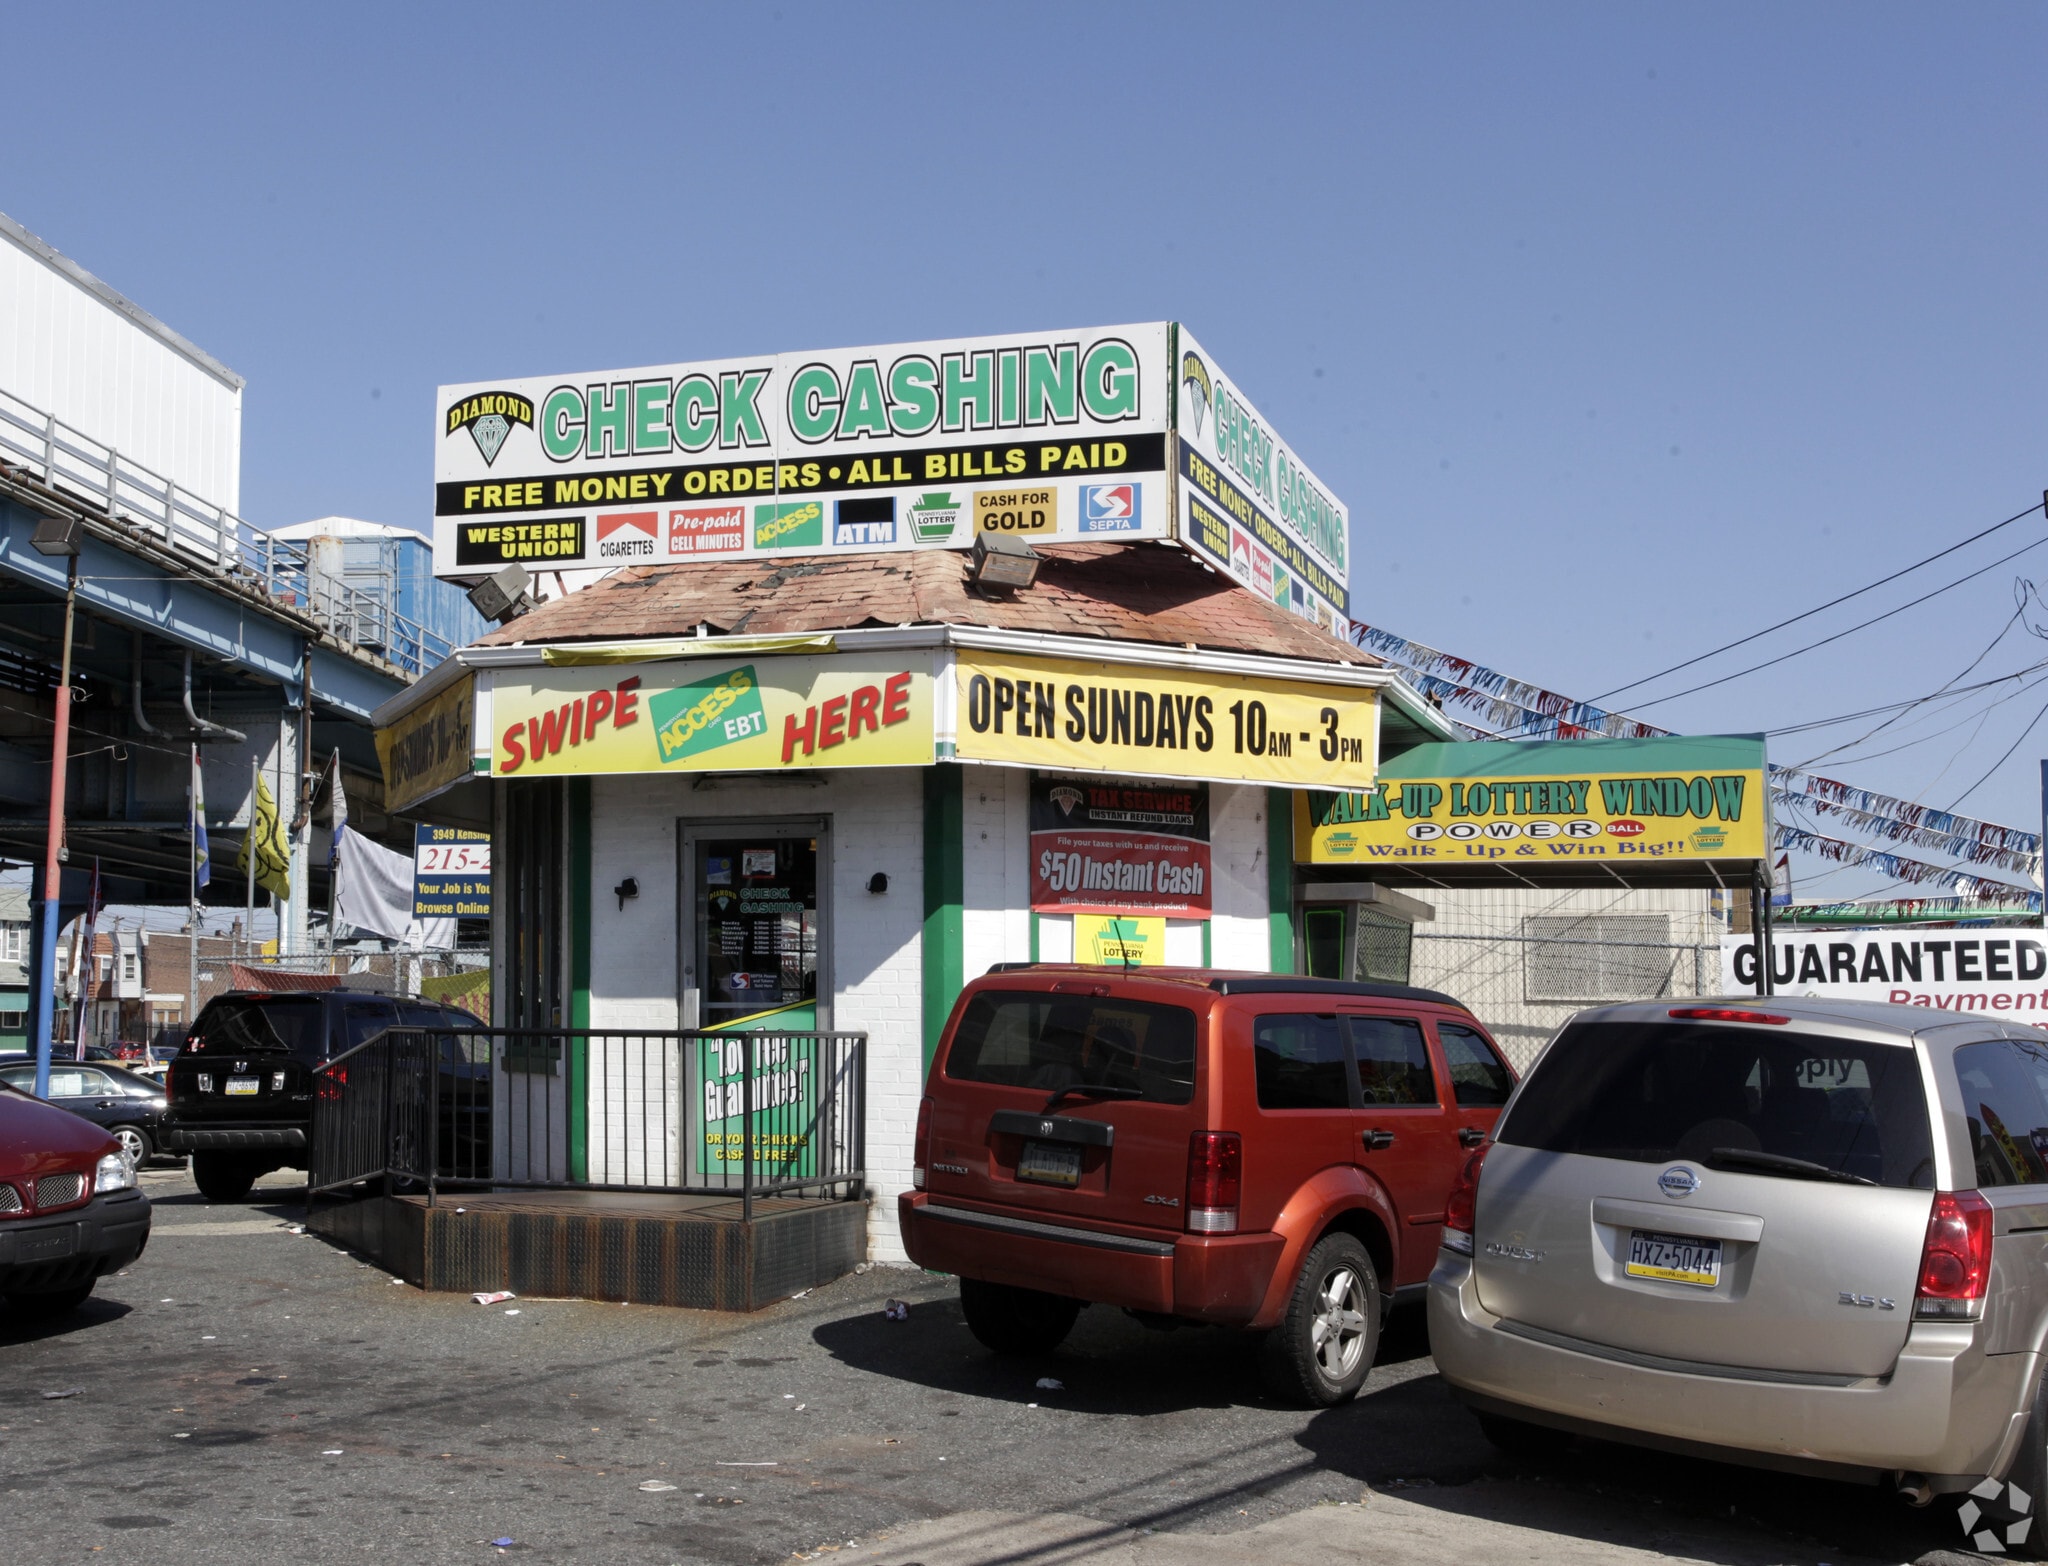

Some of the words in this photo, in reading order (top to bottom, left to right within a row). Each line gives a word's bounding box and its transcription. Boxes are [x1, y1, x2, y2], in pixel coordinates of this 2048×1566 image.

[539, 368, 774, 463] CHECK
[787, 337, 1141, 445] CASHING
[449, 395, 532, 430] DIAMOND
[464, 482, 544, 509] FREE
[555, 473, 672, 503] MONEY
[683, 463, 821, 494] ORDERS
[847, 457, 912, 484] ALL
[925, 449, 1027, 478] BILLS
[1040, 442, 1128, 471] PAID
[1213, 379, 1275, 511] CHECK
[1277, 449, 1346, 579] CASHING
[980, 495, 1017, 508] CASH
[1022, 493, 1050, 506] FOR
[672, 510, 742, 533] Pre-paid
[756, 503, 820, 546] ACCESS
[918, 516, 957, 525] LOTTERY
[983, 510, 1046, 531] GOLD
[1088, 519, 1132, 531] SEPTA
[1192, 500, 1229, 544] WESTERN
[467, 522, 576, 544] WESTERN
[835, 522, 893, 545] ATM
[1189, 452, 1217, 497] FREE
[1219, 479, 1253, 528] MONEY
[1255, 512, 1288, 559] ORDERS
[1292, 547, 1307, 577] ALL
[1307, 561, 1328, 595] BILLS
[1328, 581, 1345, 610] PAID
[501, 540, 576, 559] UNION
[600, 540, 655, 558] CIGARETTES
[671, 535, 694, 552] CELL
[696, 533, 742, 550] MINUTES
[1203, 527, 1229, 560] UNION
[500, 675, 641, 773] SWIPE
[780, 670, 911, 763] HERE
[660, 671, 752, 757] ACCESS
[708, 715, 722, 729] CARD
[968, 674, 1056, 740] OPEN
[1065, 684, 1214, 753] SUNDAYS
[1228, 699, 1292, 758] 10AM
[1319, 707, 1363, 764] 3PM
[723, 710, 762, 740] EBT
[1051, 788, 1082, 800] DIAMOND
[1089, 788, 1120, 809] TAX
[1123, 790, 1192, 813] SERVICE
[1308, 782, 1443, 828] WALK-UP
[1450, 779, 1591, 817] LOTTERY
[1599, 776, 1746, 823] WINDOW
[1091, 809, 1129, 820] INSTANT
[1130, 811, 1163, 823] REFUND
[1165, 814, 1193, 825] LOANS
[433, 829, 455, 840] 3949
[1415, 823, 1593, 838] POWER
[1607, 824, 1646, 834] BALL
[1057, 837, 1072, 846] File
[1073, 839, 1091, 848] your
[1093, 839, 1114, 848] taxes
[1115, 841, 1133, 849] with
[1144, 842, 1160, 851] and
[1161, 844, 1189, 852] receive
[1366, 844, 1437, 857] Walk
[1466, 844, 1506, 859] Up
[1515, 843, 1539, 856] &
[1547, 842, 1607, 856] Win
[1617, 840, 1685, 857] Big!!
[423, 848, 491, 870] 215-2
[1040, 850, 1082, 893] $50
[1082, 856, 1155, 892] Instant
[1157, 860, 1204, 895] Cash
[418, 883, 440, 894] Your
[442, 883, 461, 894] Job
[463, 883, 472, 894] is
[709, 889, 737, 900] DIAMOND
[740, 888, 790, 899] CHECK
[416, 902, 454, 914] Browse
[456, 902, 490, 914] Online
[740, 902, 804, 913] CASHING
[1060, 896, 1079, 905] With
[1080, 898, 1107, 907] choice
[1108, 899, 1116, 907] of
[1117, 901, 1132, 909] any
[1133, 900, 1153, 909] bank
[1103, 941, 1145, 950] PENNSYLVANIA
[1103, 948, 1144, 958] LOTTERY
[1733, 940, 2047, 985] GUARANTEED
[933, 1162, 968, 1175] NITRO
[1663, 1176, 1695, 1186] NISSAN
[1653, 1235, 1699, 1246] PENNSYLVANIA
[1486, 1243, 1547, 1262] QUEST
[1656, 1270, 1689, 1279] visitPA.com
